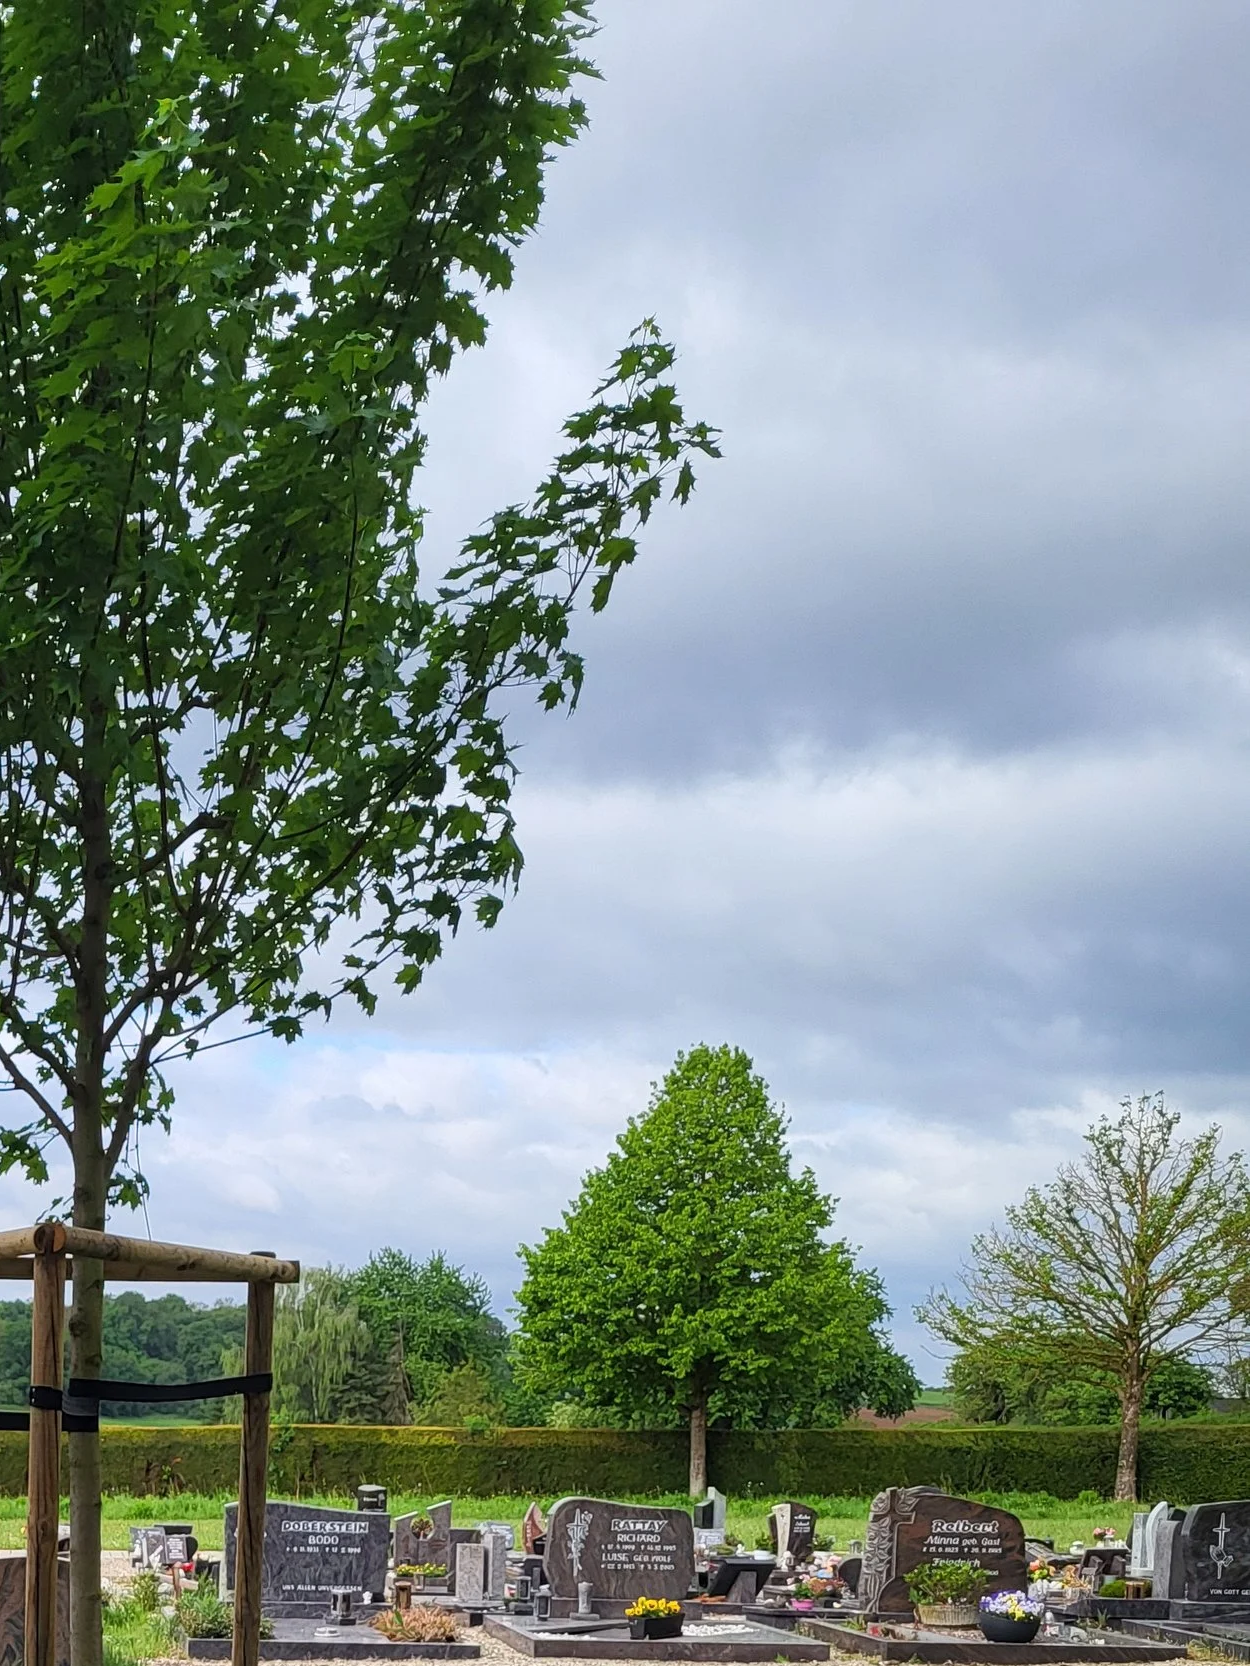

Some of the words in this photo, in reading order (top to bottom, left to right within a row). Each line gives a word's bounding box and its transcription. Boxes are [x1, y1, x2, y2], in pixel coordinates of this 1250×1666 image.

[281, 1520, 369, 1533] DOBERSTEIN
[611, 1518, 668, 1532] RATTAY
[308, 1535, 339, 1544] BODO
[617, 1534, 661, 1542] RICHARD
[924, 1536, 959, 1545] Minna
